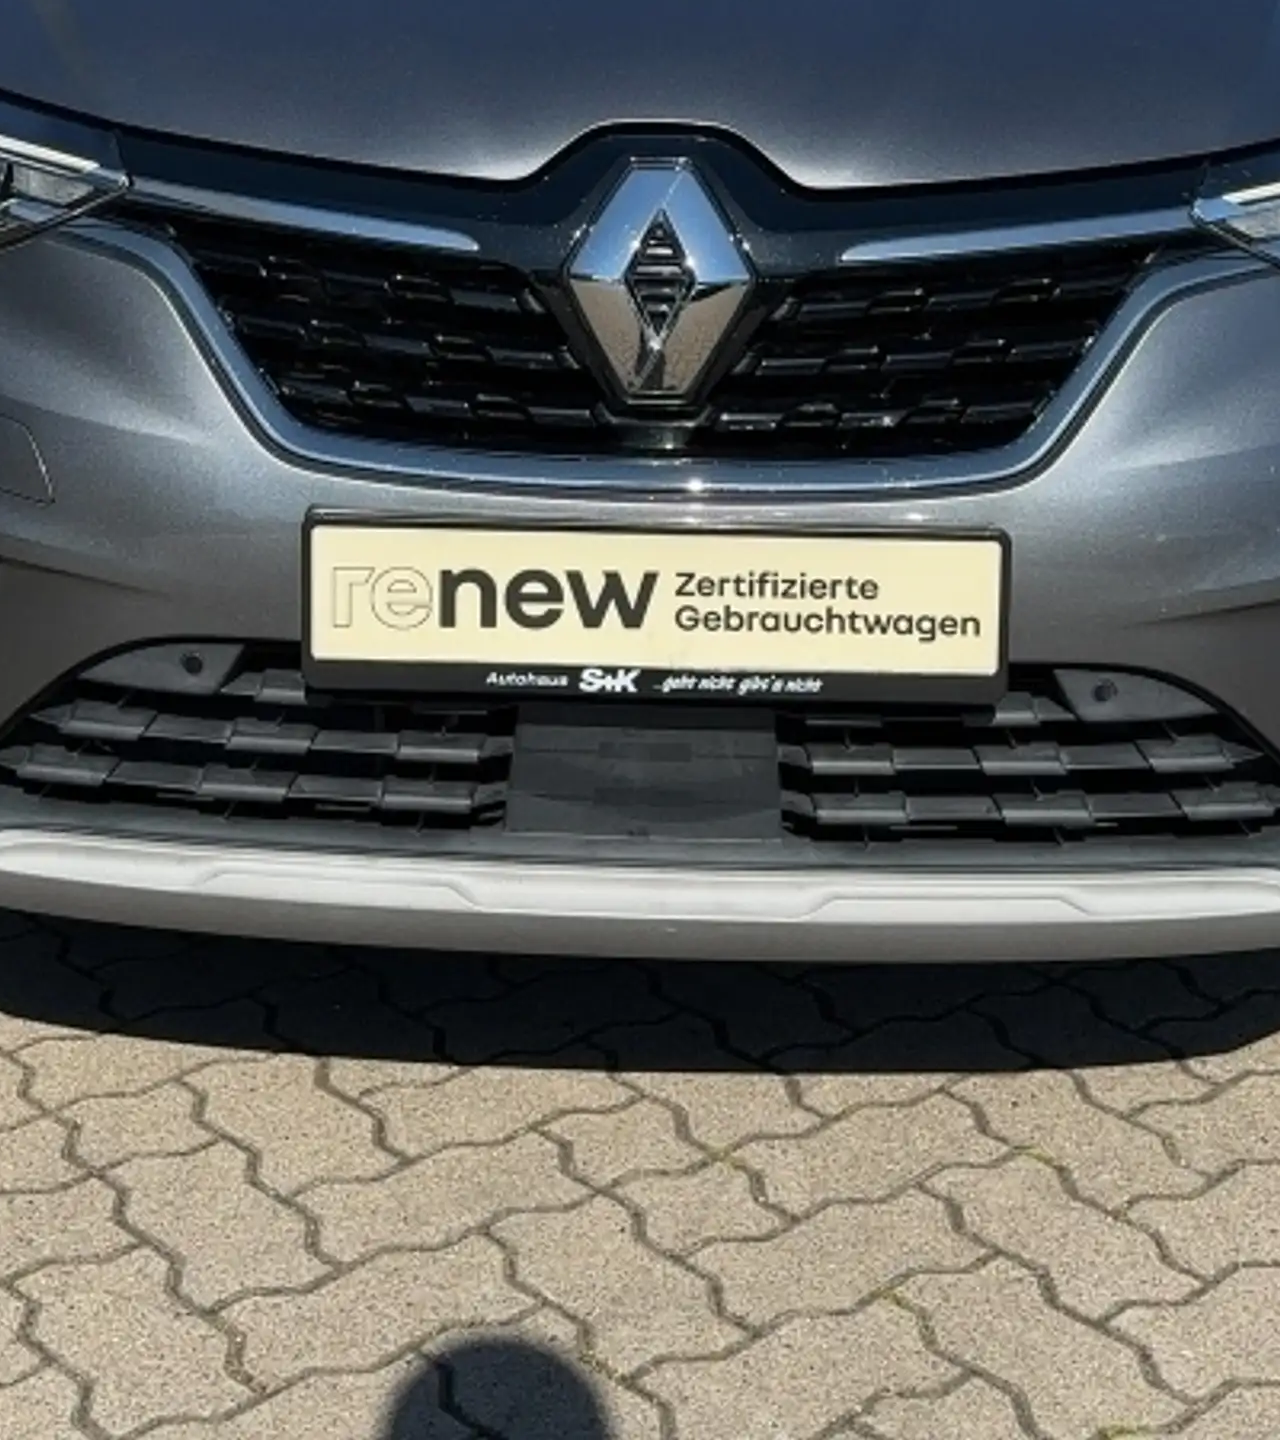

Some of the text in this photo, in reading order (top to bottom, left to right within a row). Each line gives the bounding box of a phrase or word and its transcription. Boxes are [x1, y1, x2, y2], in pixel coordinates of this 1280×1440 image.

[330, 565, 660, 630] renew
[674, 572, 880, 601] Zertifizierte
[674, 603, 982, 643] Gebrauchtwagen
[485, 672, 569, 688] Autohaus
